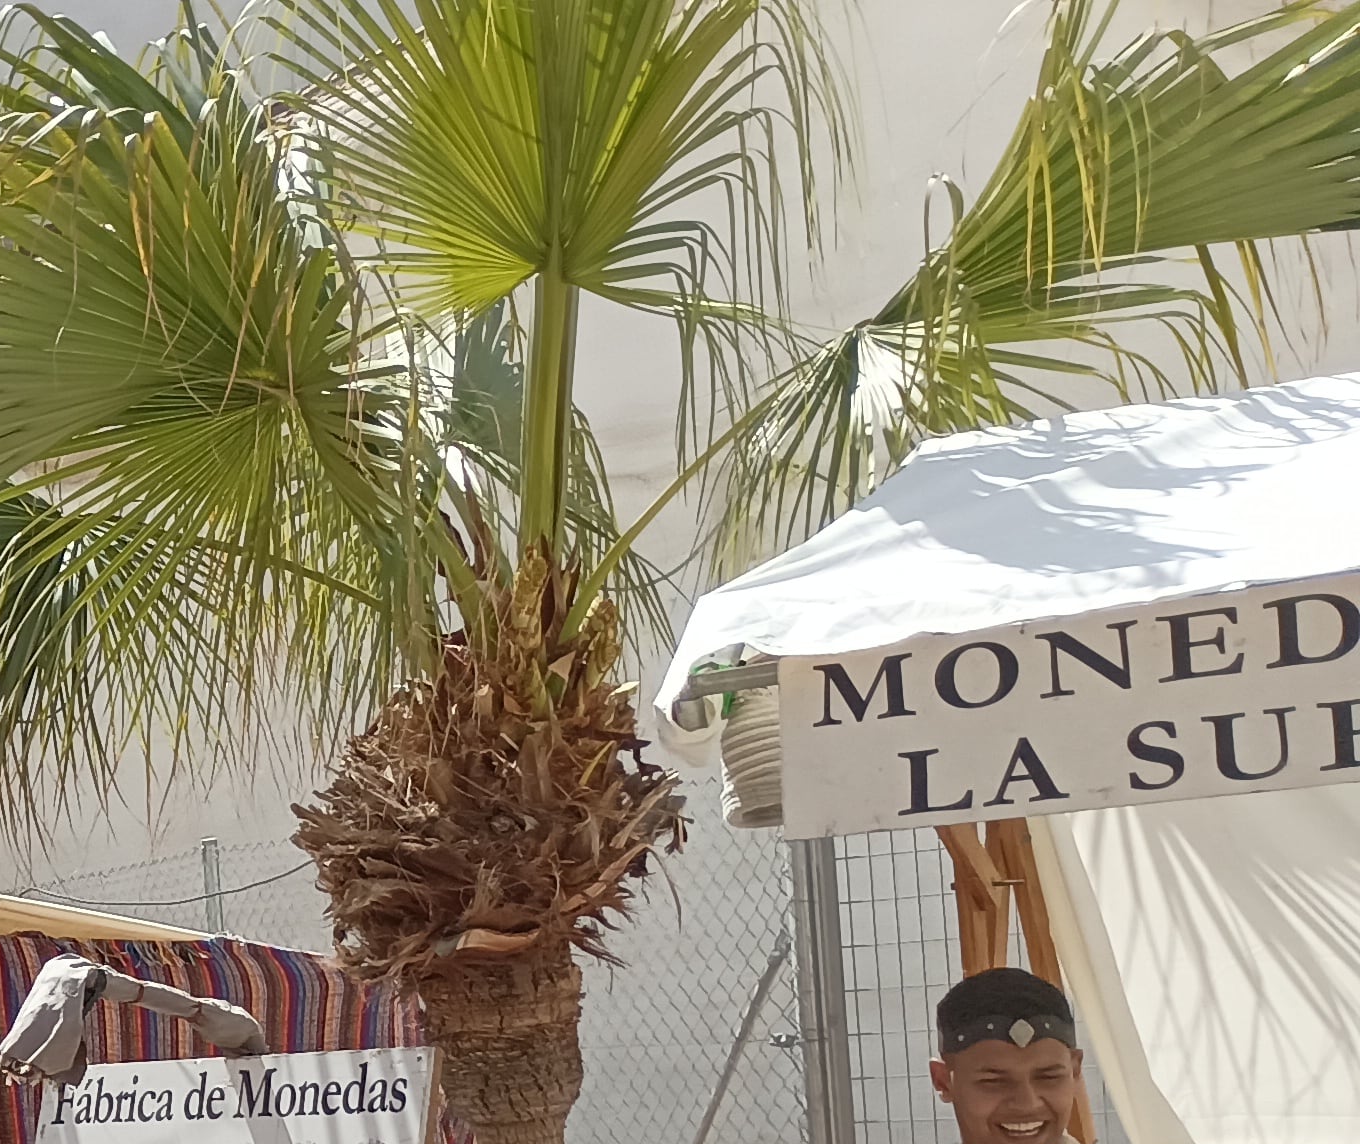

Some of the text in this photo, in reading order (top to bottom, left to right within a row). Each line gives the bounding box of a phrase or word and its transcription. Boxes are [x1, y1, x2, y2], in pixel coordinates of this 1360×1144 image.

[813, 593, 1360, 728] MONED
[898, 736, 1070, 816] LA
[51, 1062, 408, 1125] Fábrica de Monedas
